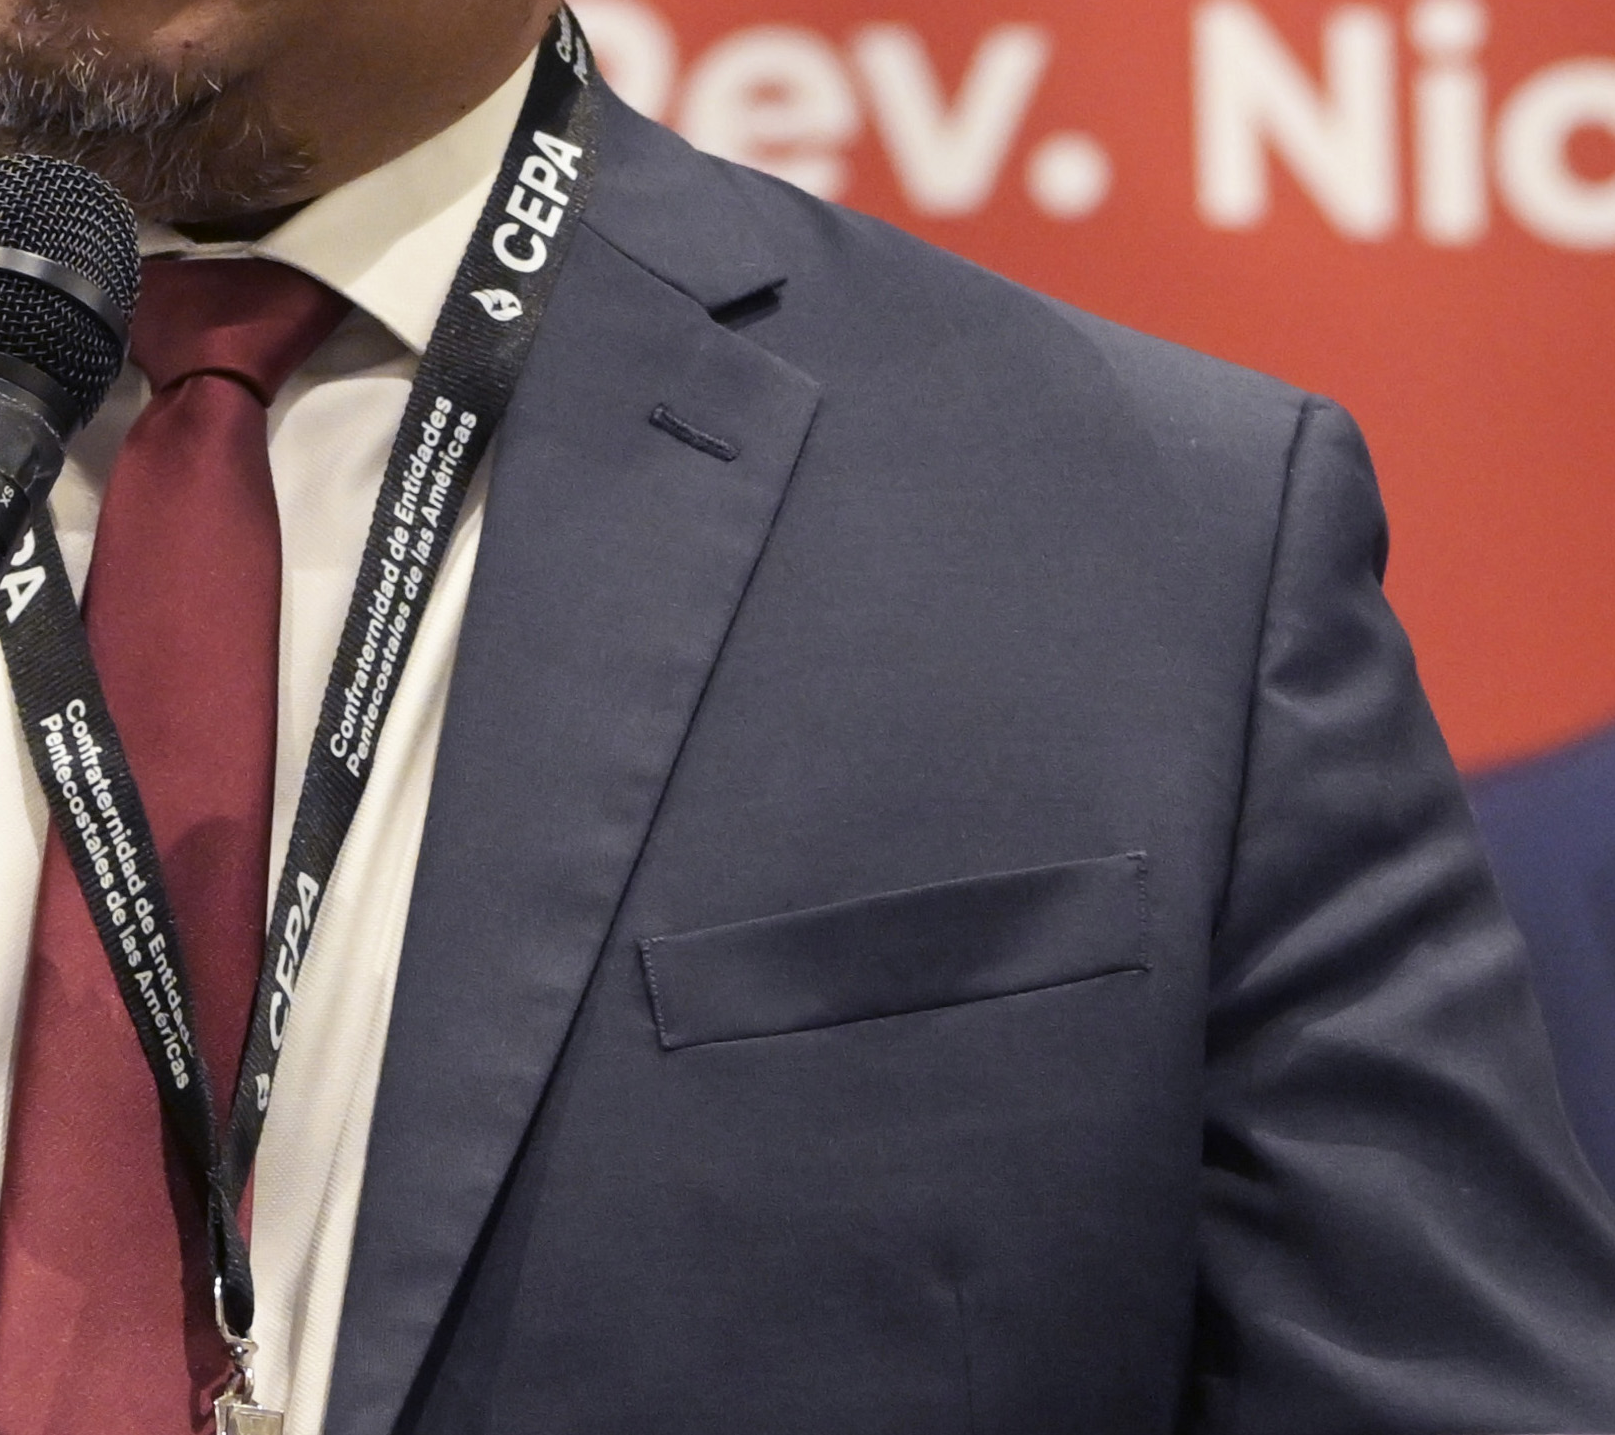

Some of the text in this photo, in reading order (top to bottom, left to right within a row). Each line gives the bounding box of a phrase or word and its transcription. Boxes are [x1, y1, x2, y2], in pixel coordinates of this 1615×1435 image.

[492, 130, 582, 273] CEPA
[330, 396, 452, 758] Confraternidad de Entidades
[347, 411, 477, 778] Pentecostales de las Américas
[40, 713, 189, 1090] Pentecostales de las Américas
[66, 698, 146, 896] Confraternidad
[134, 896, 155, 935] de
[270, 871, 319, 1050] CEPA
